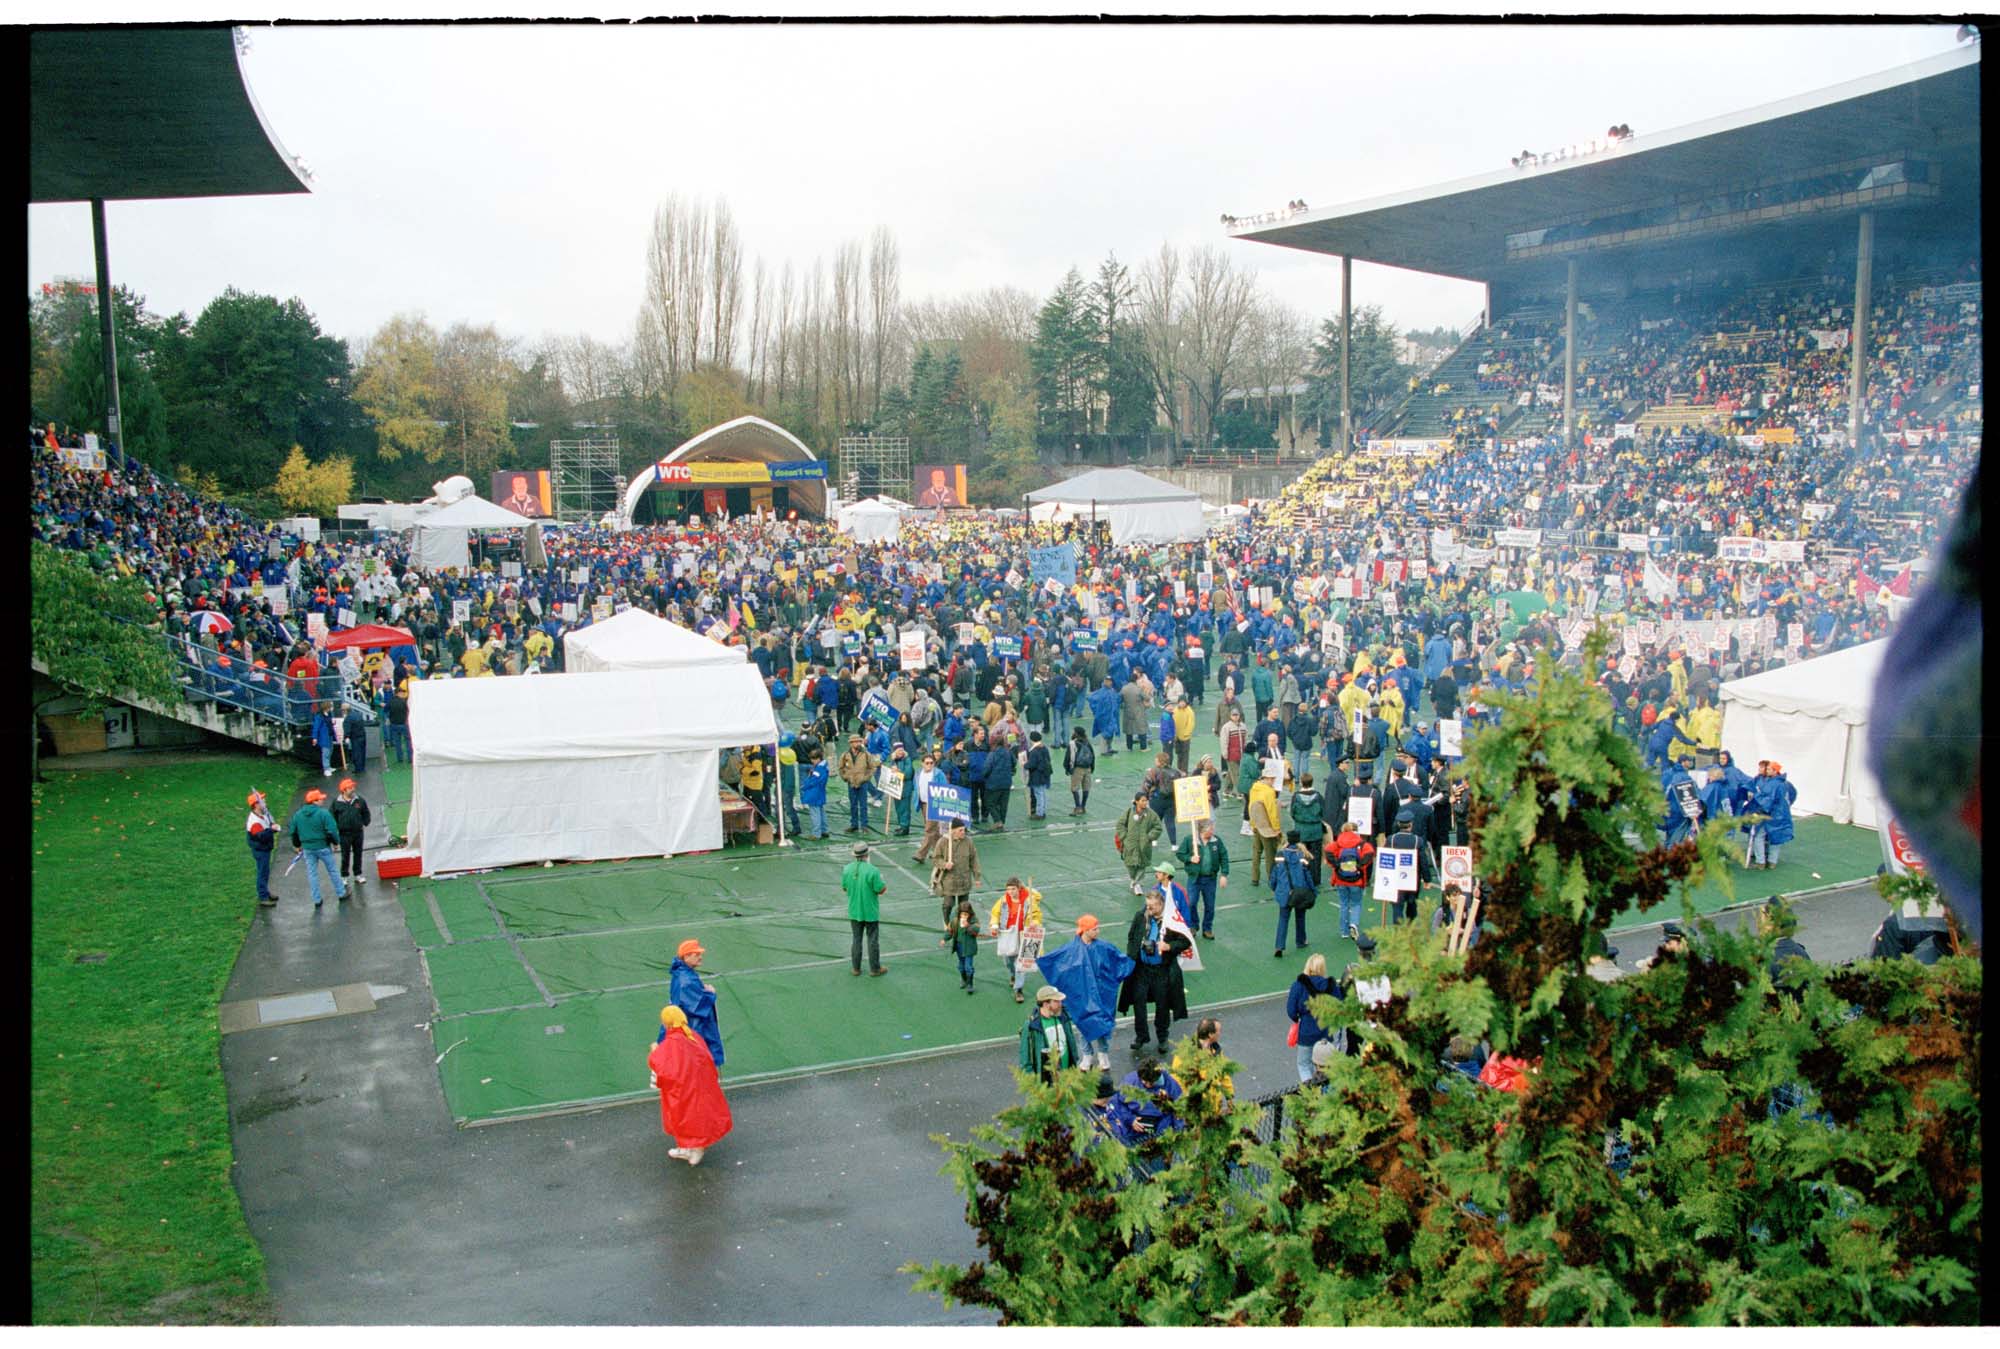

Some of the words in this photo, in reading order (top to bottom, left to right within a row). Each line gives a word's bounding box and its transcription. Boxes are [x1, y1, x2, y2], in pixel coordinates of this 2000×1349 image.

[658, 466, 691, 479] WTO
[869, 696, 889, 714] WTO
[929, 785, 958, 800] WTO
[1446, 847, 1467, 856] IBEW
